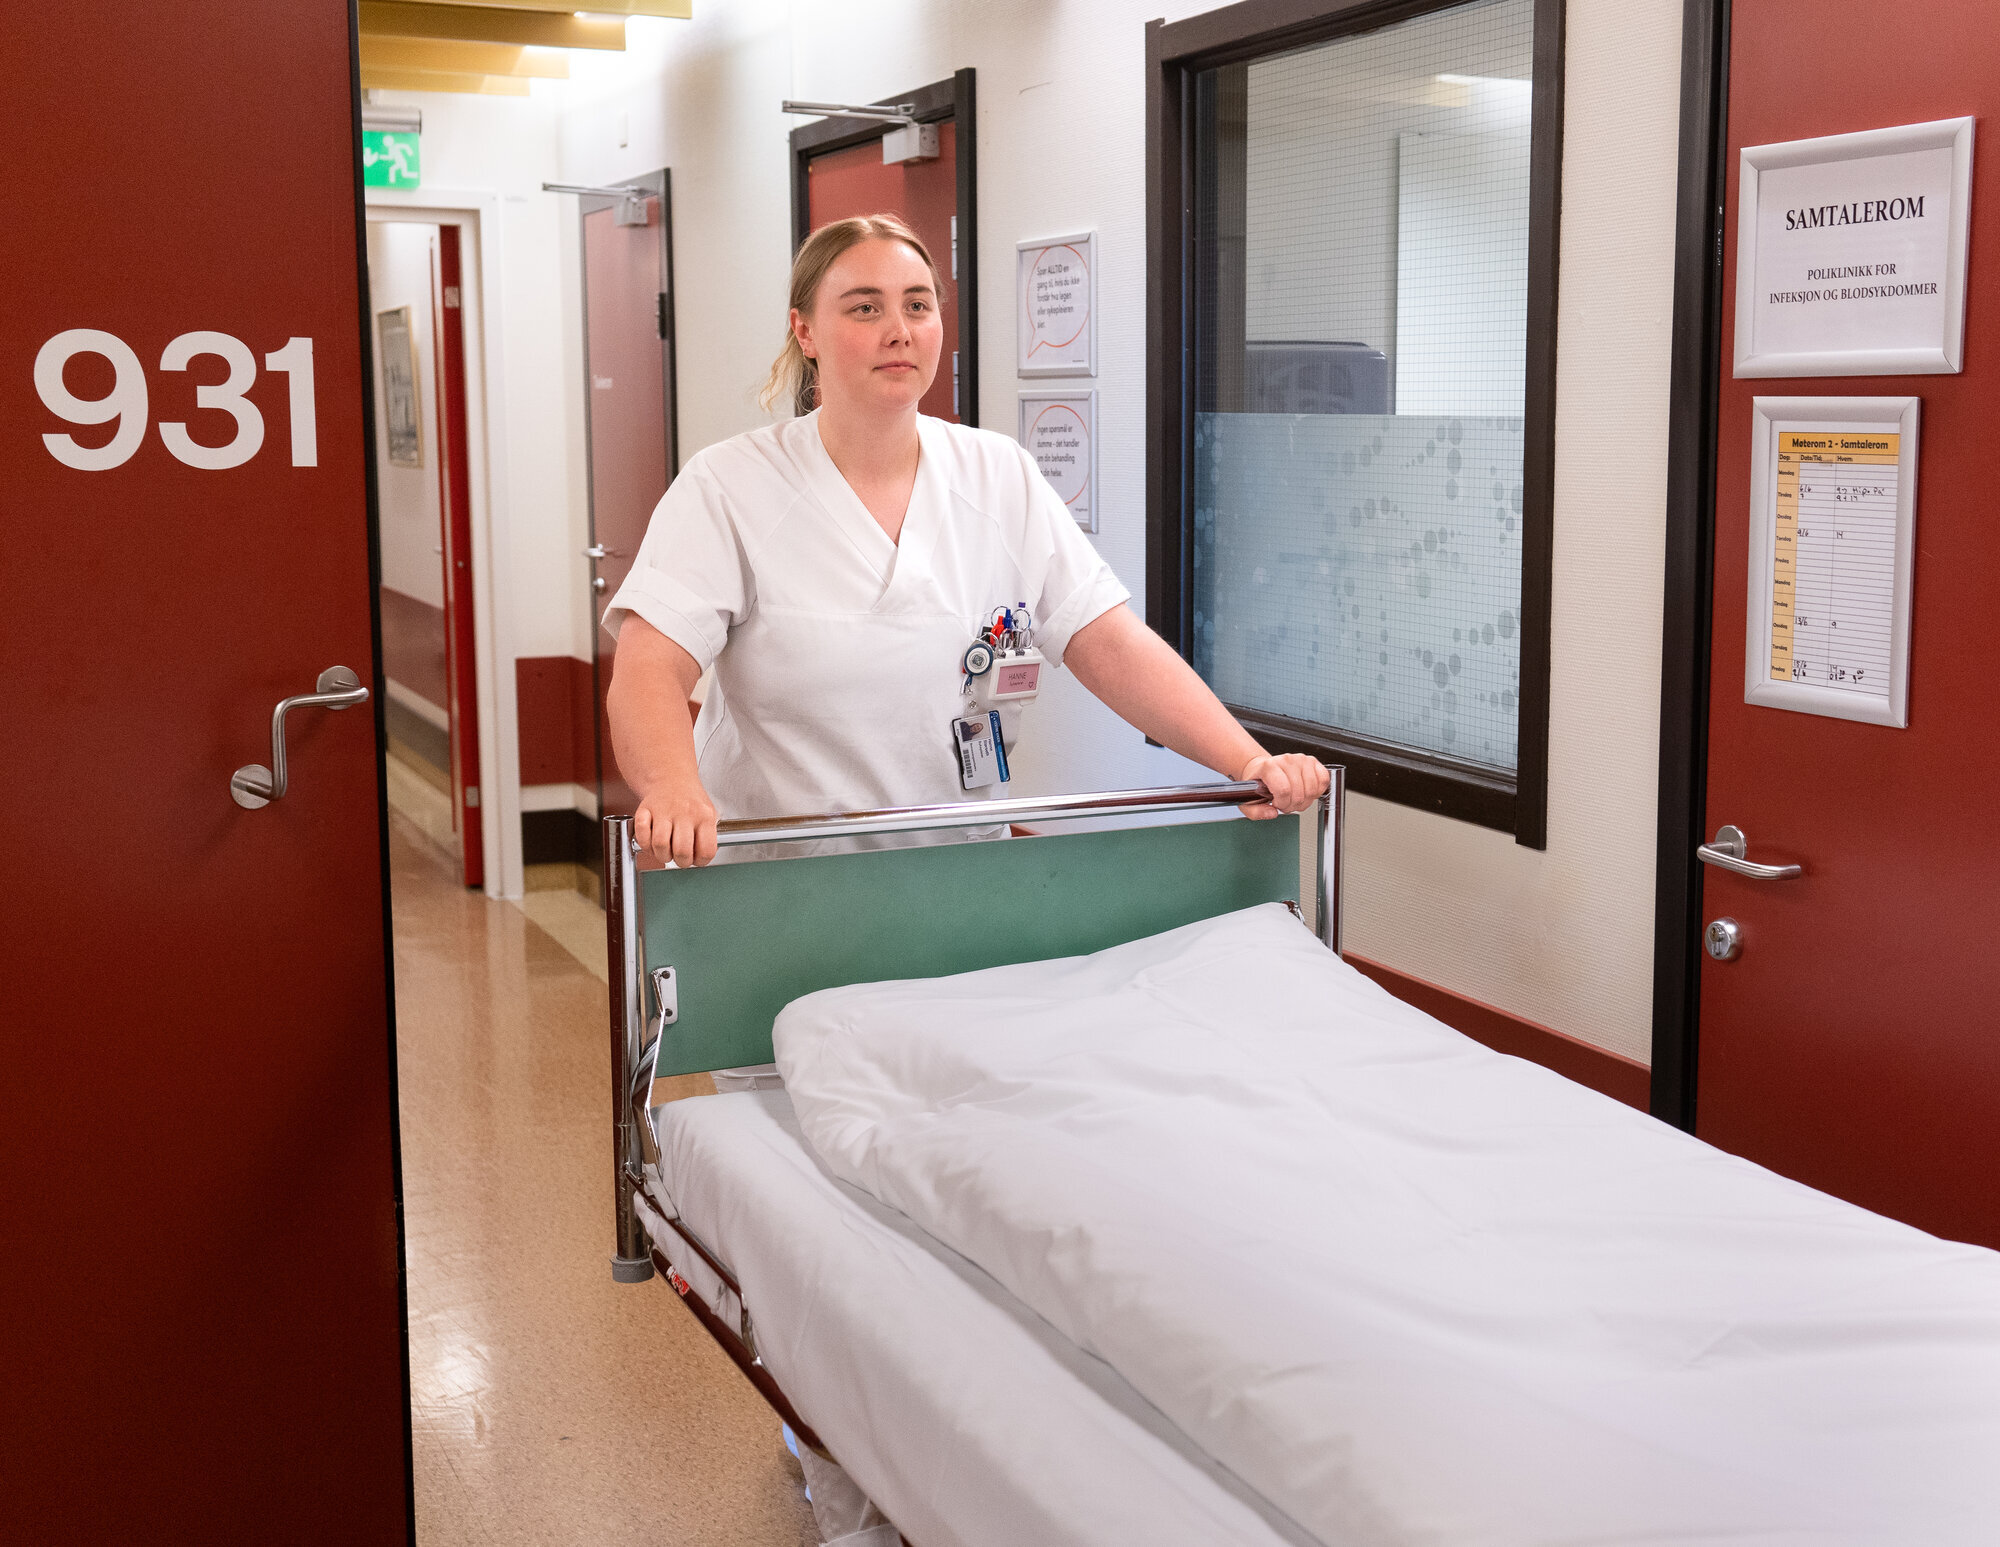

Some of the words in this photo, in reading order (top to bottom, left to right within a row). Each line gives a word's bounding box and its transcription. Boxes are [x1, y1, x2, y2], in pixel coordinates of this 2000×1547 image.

[1785, 195, 1925, 231] SAMTALEROM
[1048, 264, 1062, 274] ALLTID
[1807, 264, 1873, 281] POLIKLINIKK
[1875, 263, 1897, 276] FOR
[1769, 289, 1821, 305] INFEKSJON
[1823, 288, 1839, 301] OG
[1840, 282, 1938, 300] BLODSYKDOMMER
[34, 328, 318, 471] 931
[1064, 438, 1080, 448] handler
[1792, 438, 1826, 449] Møterom
[1828, 440, 1833, 449] 2
[1840, 439, 1889, 450] Samtalerom
